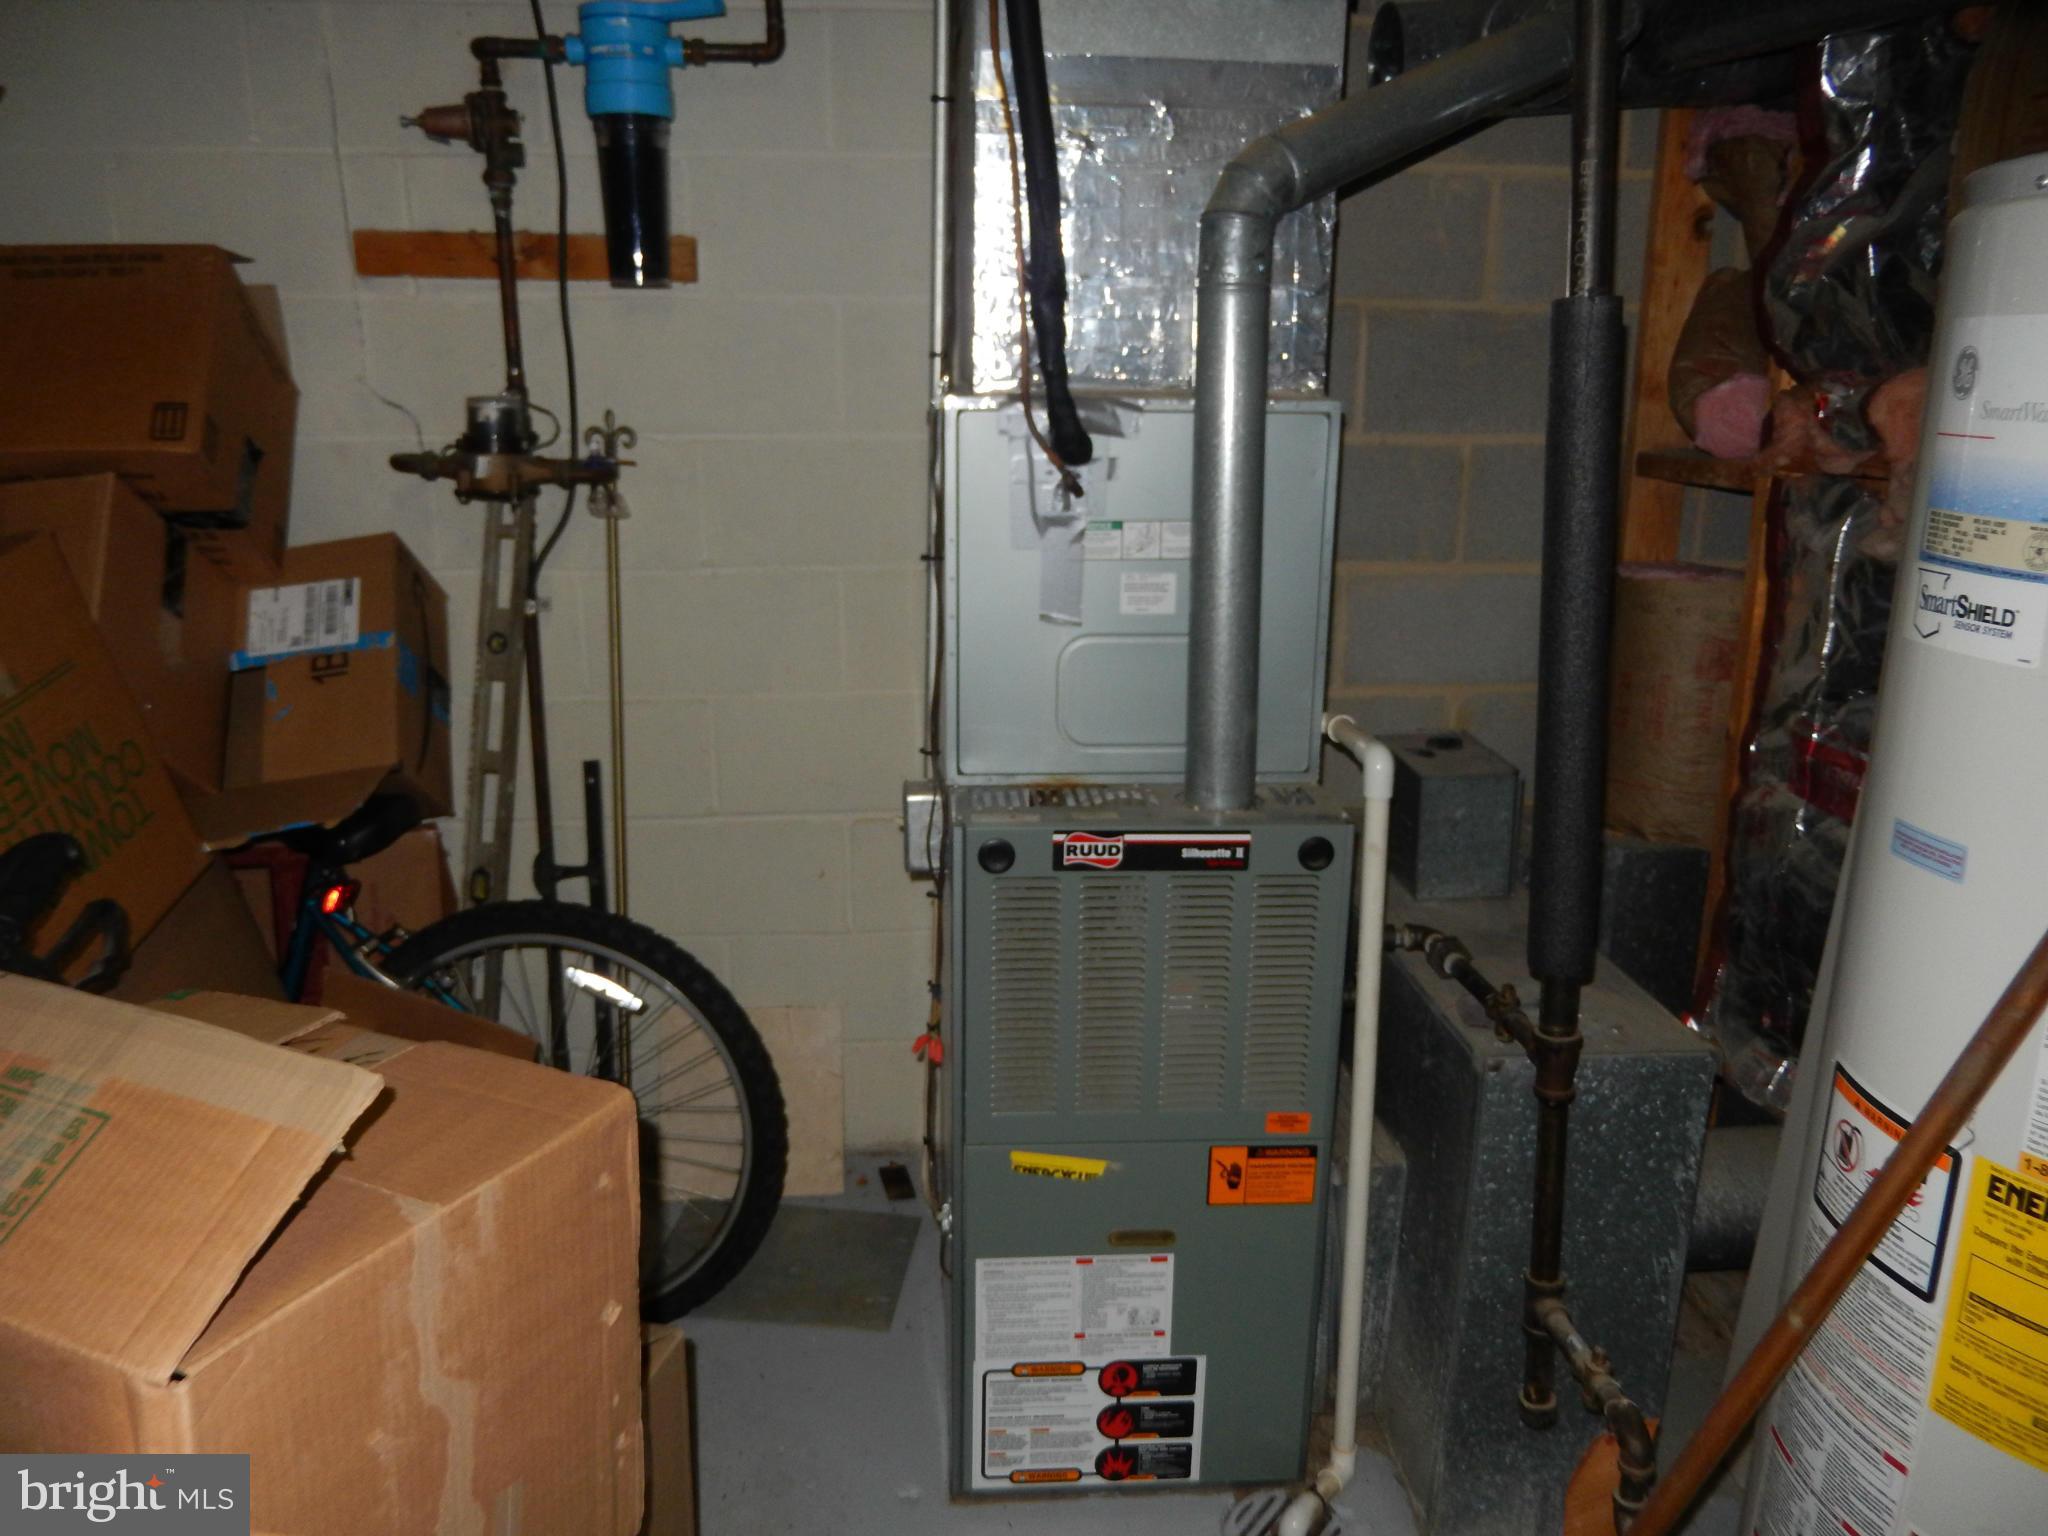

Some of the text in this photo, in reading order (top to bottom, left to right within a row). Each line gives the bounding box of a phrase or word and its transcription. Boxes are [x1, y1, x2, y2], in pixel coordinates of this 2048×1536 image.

[1980, 400, 2048, 423] SmartWa
[1953, 619, 2014, 640] SENSOR SYSTEM
[1065, 844, 1122, 857] RUUD
[1862, 1106, 1901, 1141] WARNIN
[1986, 1173, 2048, 1222] ENE
